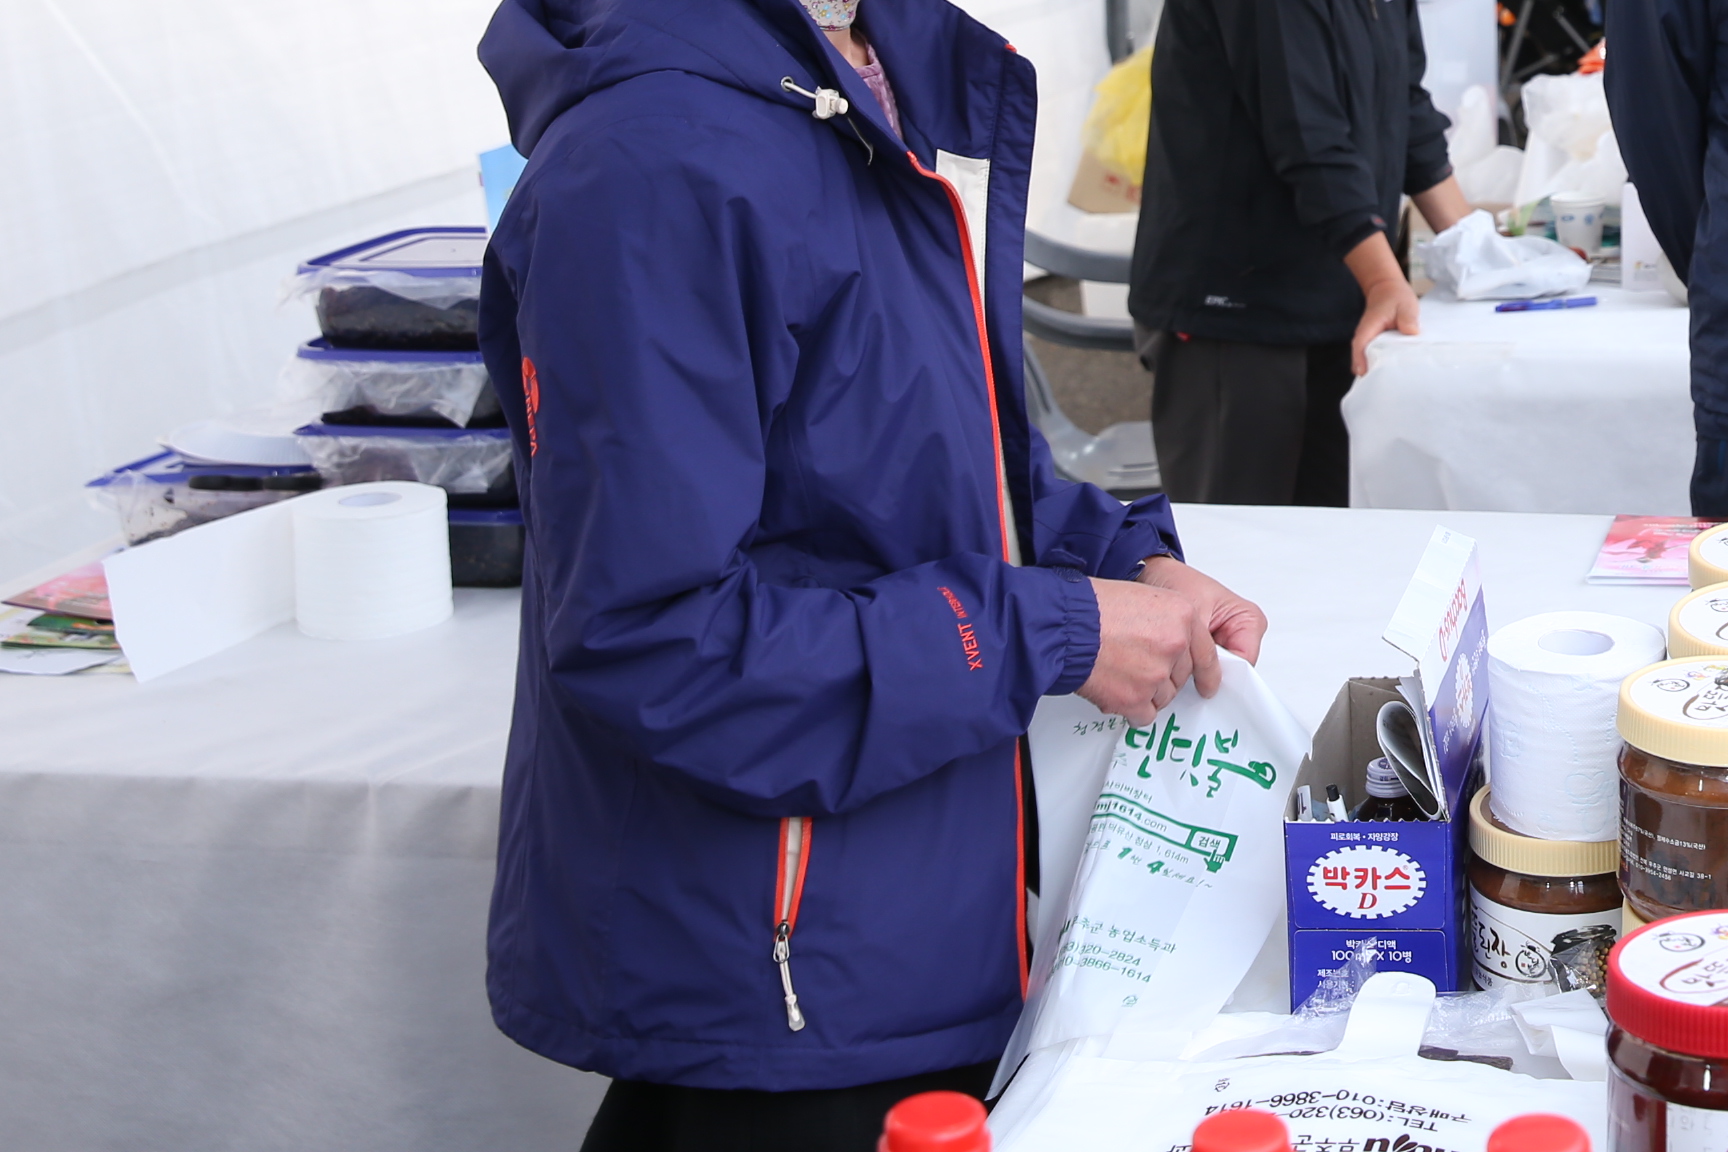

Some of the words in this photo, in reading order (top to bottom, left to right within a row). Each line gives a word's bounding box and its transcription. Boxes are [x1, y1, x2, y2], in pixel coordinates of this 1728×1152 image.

[957, 623, 984, 672] XVENT
[1094, 799, 1168, 833] mj1614.com
[1198, 836, 1221, 849] 검색
[1367, 832, 1398, 842] 자양강장
[1323, 866, 1412, 891] 박카스
[1357, 892, 1378, 909] D
[1389, 950, 1412, 964] 10병
